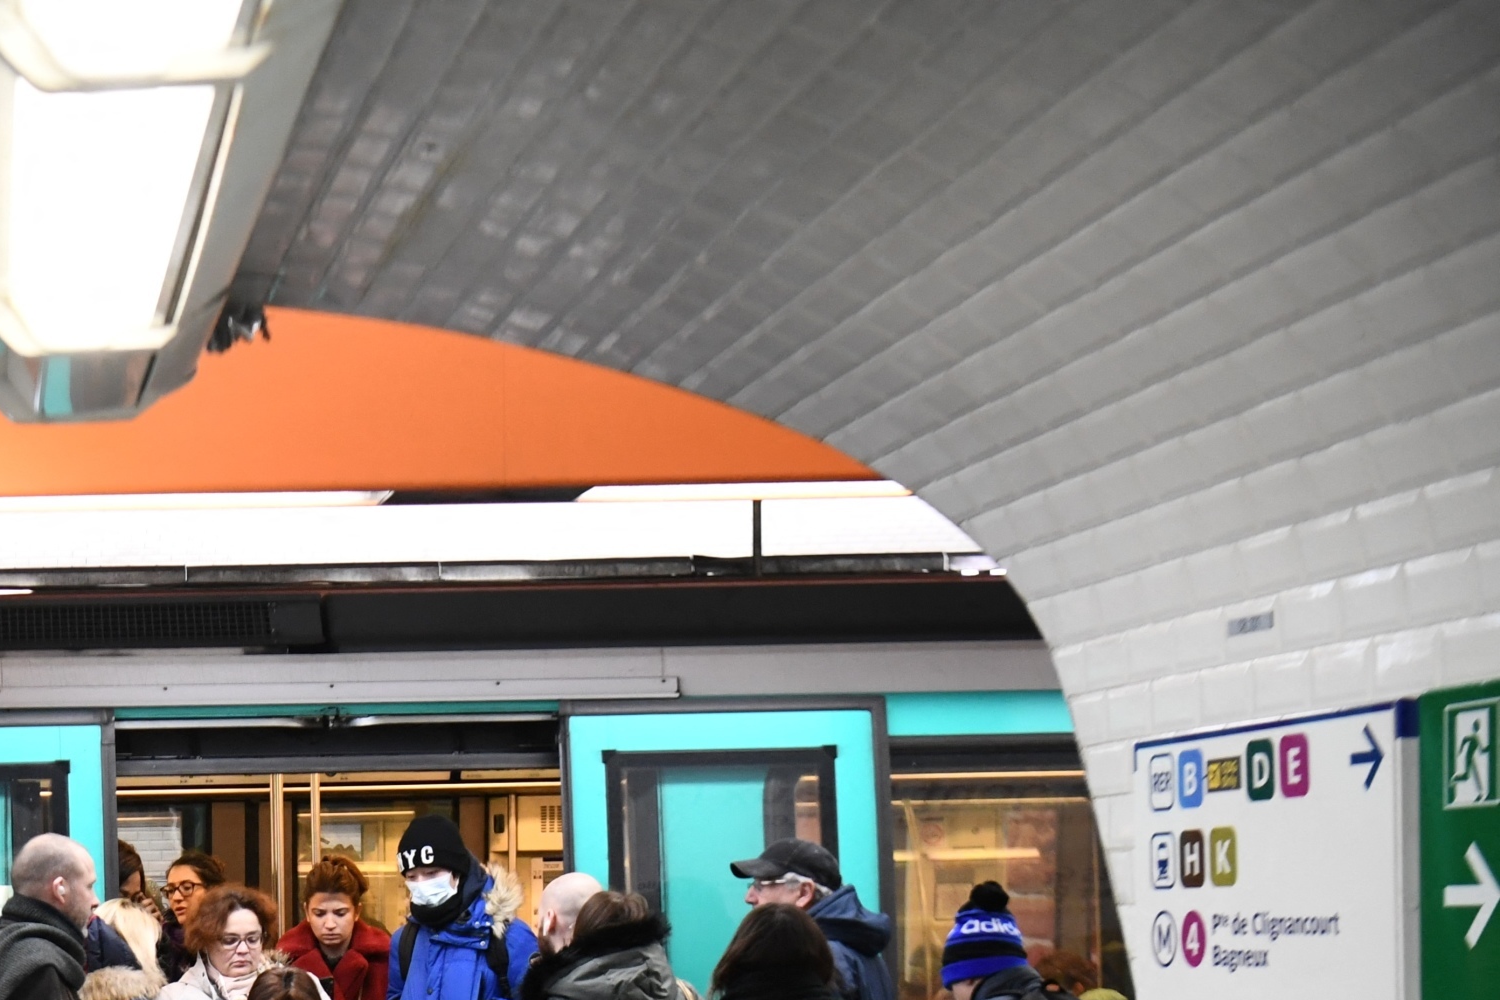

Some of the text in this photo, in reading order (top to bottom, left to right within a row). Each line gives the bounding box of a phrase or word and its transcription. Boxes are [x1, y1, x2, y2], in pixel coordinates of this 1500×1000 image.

[1183, 761, 1198, 798] B
[1252, 750, 1271, 790] D
[1287, 746, 1303, 785] E
[1184, 839, 1232, 877] H K
[960, 916, 1022, 935] adid
[1186, 920, 1201, 958] 4
[1232, 911, 1248, 935] de
[1252, 909, 1341, 941] Clignancourt
[1212, 944, 1270, 974] Bagneux
